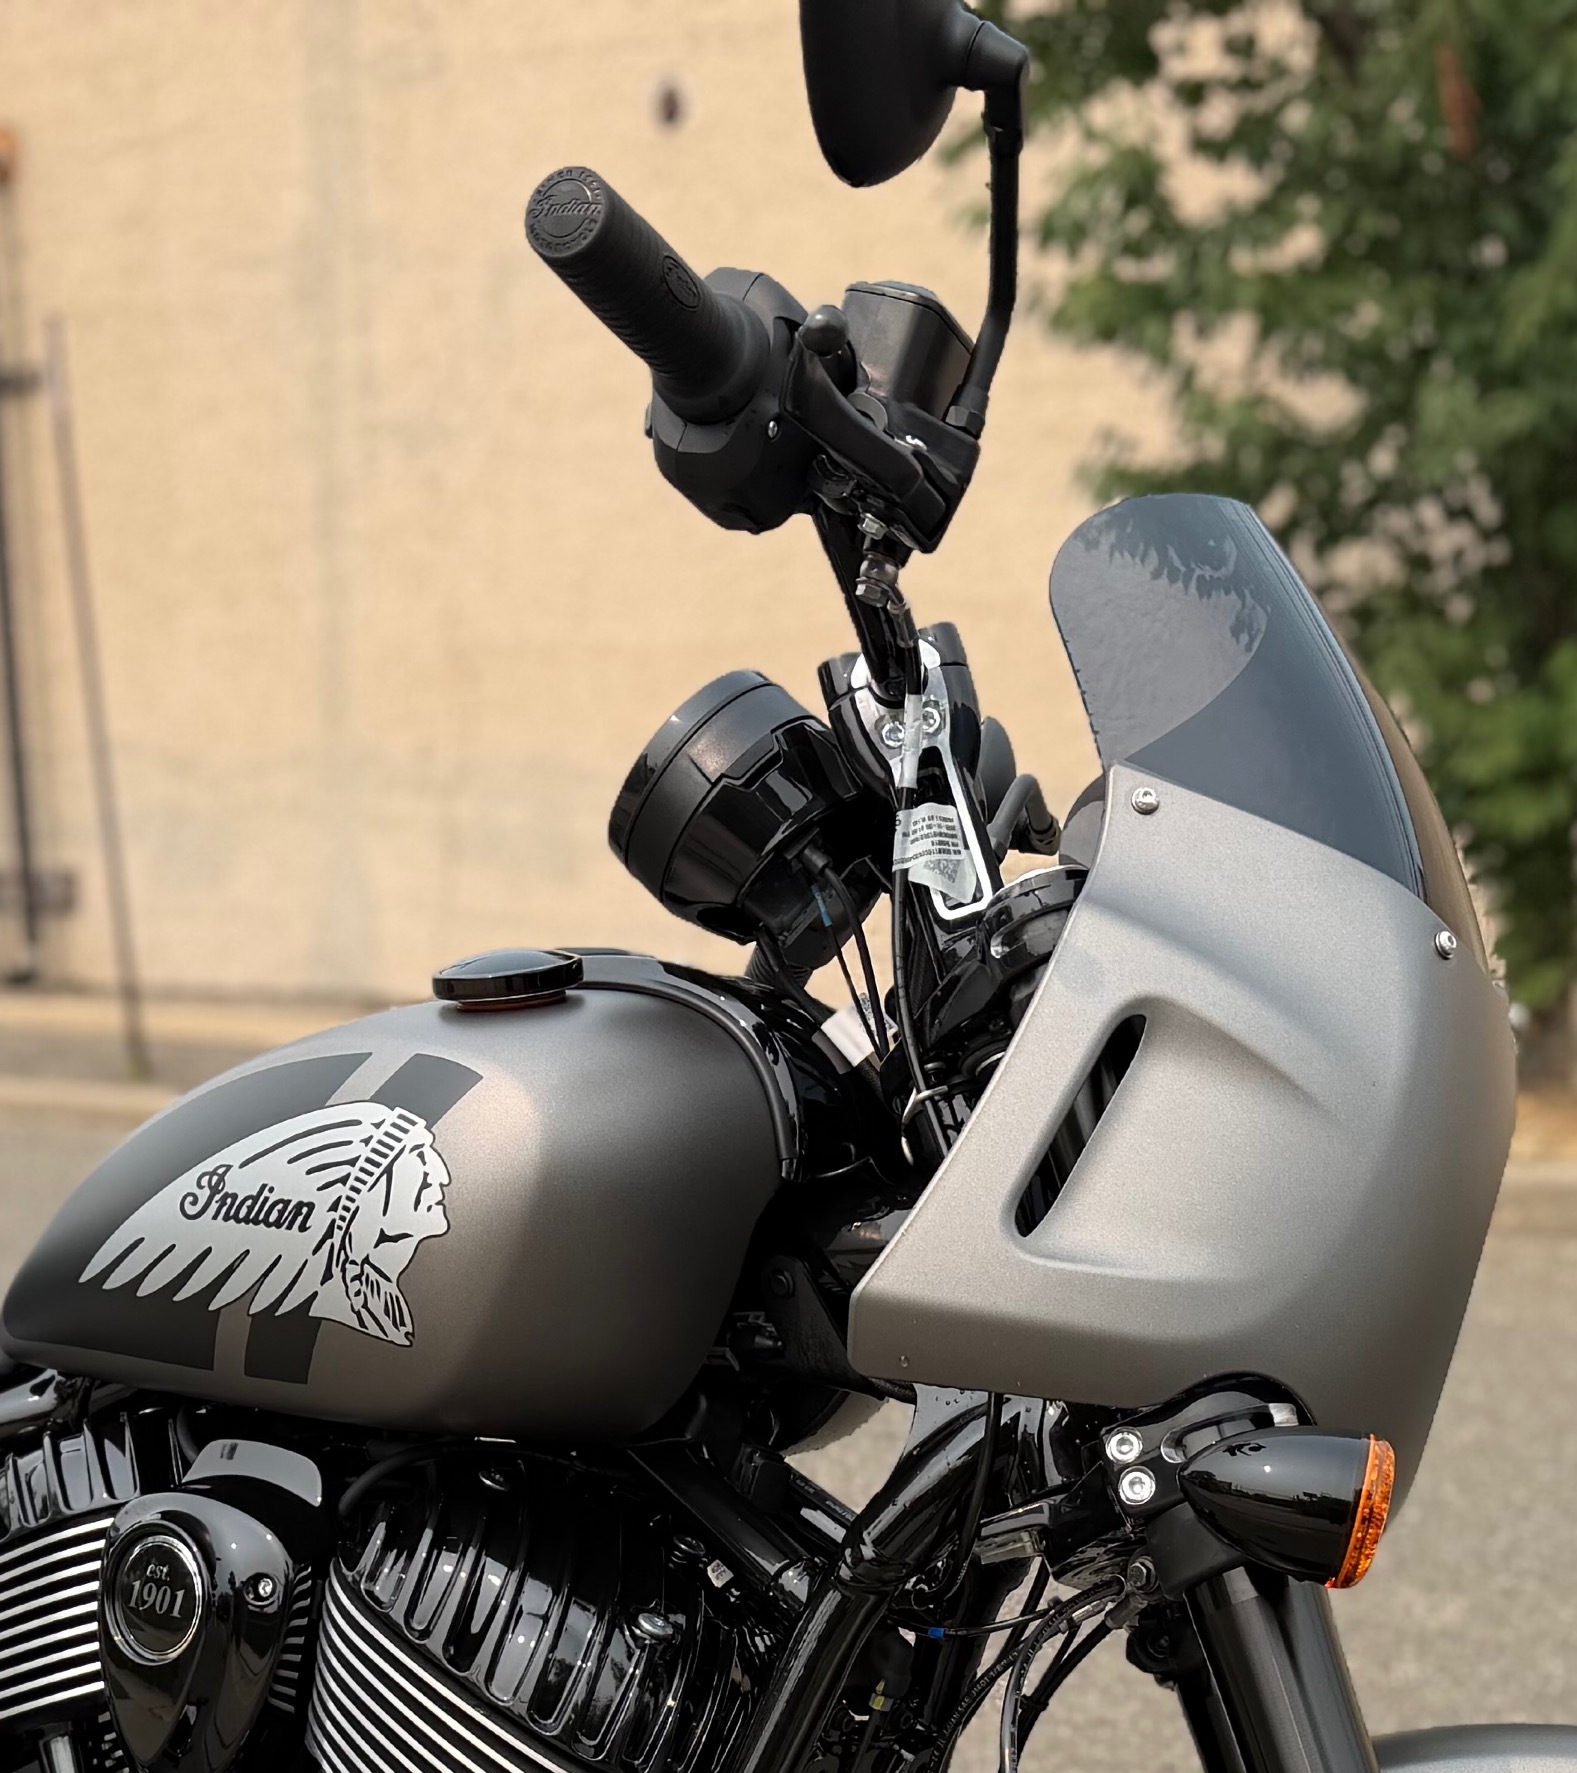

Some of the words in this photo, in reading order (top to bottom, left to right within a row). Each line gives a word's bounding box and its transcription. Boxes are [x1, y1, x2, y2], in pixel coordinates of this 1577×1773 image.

[528, 194, 602, 219] Indian
[179, 1164, 316, 1233] Indian
[146, 1563, 171, 1582] est.
[128, 1580, 185, 1618] 1901
